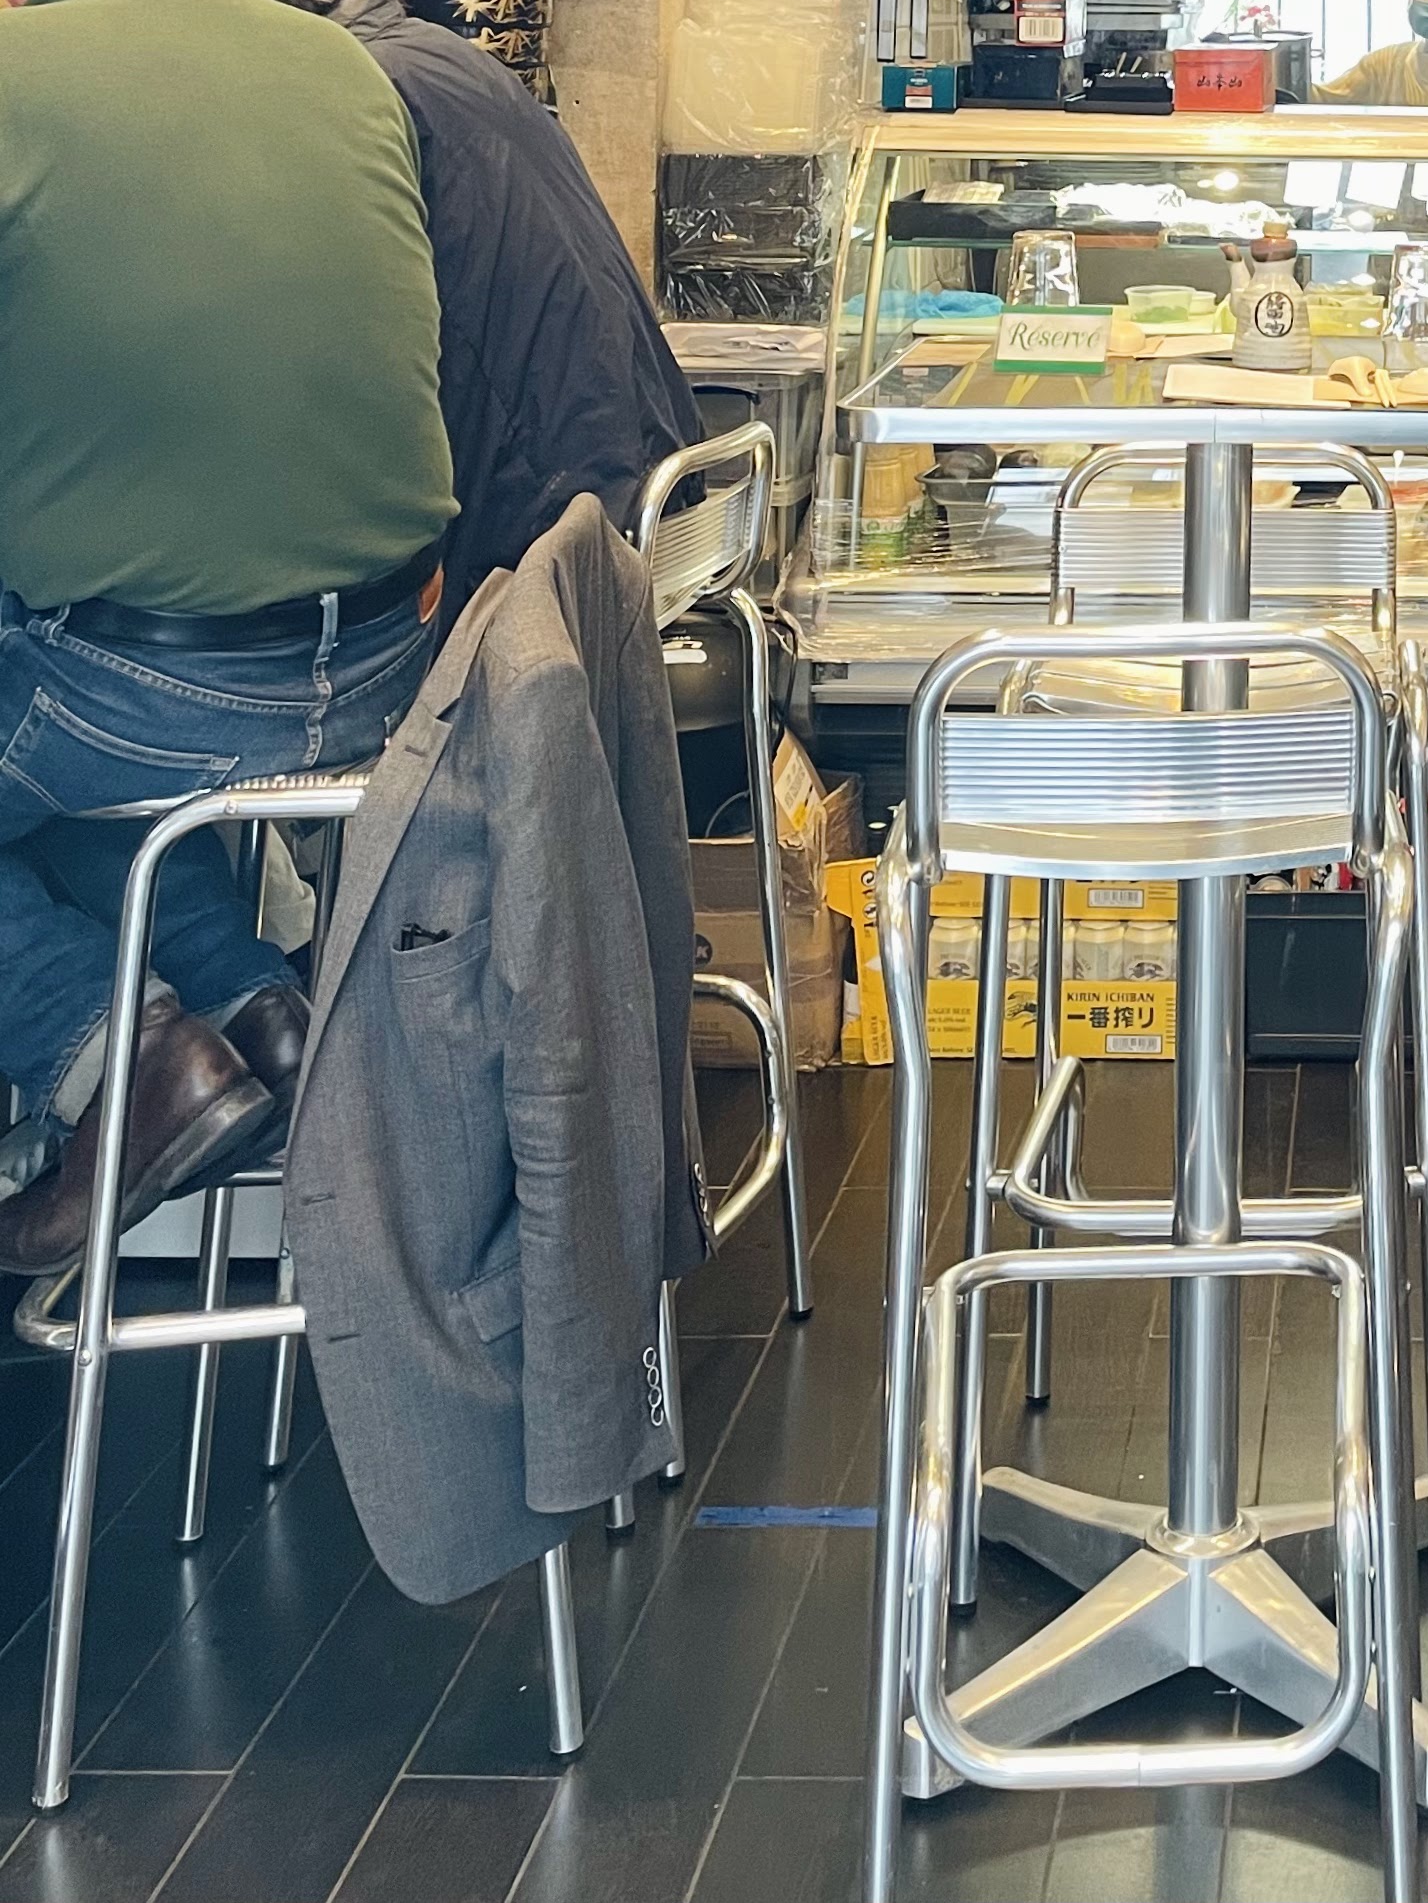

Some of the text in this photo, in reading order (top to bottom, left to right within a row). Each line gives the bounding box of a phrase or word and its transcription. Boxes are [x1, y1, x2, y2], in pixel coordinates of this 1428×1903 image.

[1008, 321, 1104, 351] Réservé
[1066, 991, 1156, 1003] KIRIN ICHIBAN
[1066, 1005, 1156, 1029] 一番搾り
